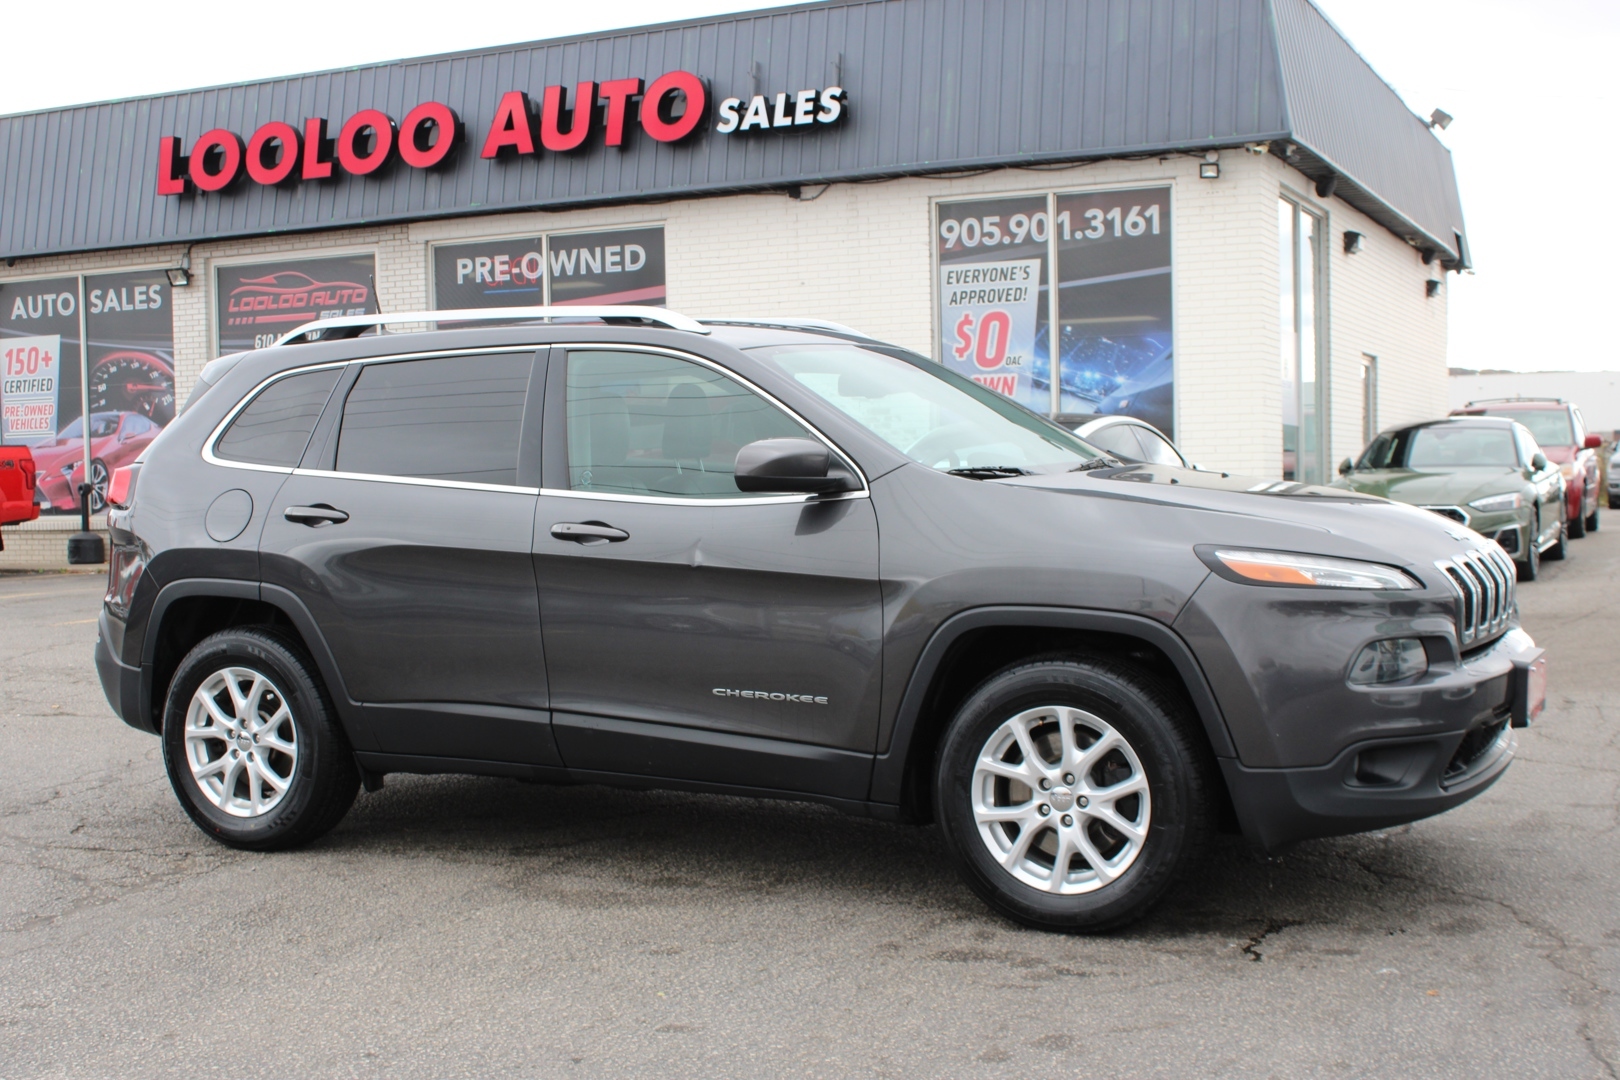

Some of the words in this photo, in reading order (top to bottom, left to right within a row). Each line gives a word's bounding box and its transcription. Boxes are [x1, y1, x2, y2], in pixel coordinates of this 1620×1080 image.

[157, 101, 456, 196] LOOLOO
[480, 70, 706, 160] AUTO
[716, 86, 845, 134] SALES
[940, 204, 1161, 248] 905.901.3161
[457, 244, 647, 284] PRE-OWNED
[946, 265, 1031, 285] EVERYONE'S
[11, 292, 75, 320] AUTO
[90, 284, 162, 314] SALES
[228, 293, 309, 312] LOOLOO
[309, 289, 368, 306] AUTO
[949, 287, 1028, 306] APPROVED!
[255, 333, 275, 349] 610
[955, 311, 1010, 368] $0
[1005, 355, 1022, 366] OAC
[5, 346, 53, 376] 150+
[4, 378, 53, 394] CERTIFIED
[4, 404, 54, 417] PRE-OWNED
[10, 417, 50, 430] VEHICLES
[712, 688, 829, 705] CHEROKEE
